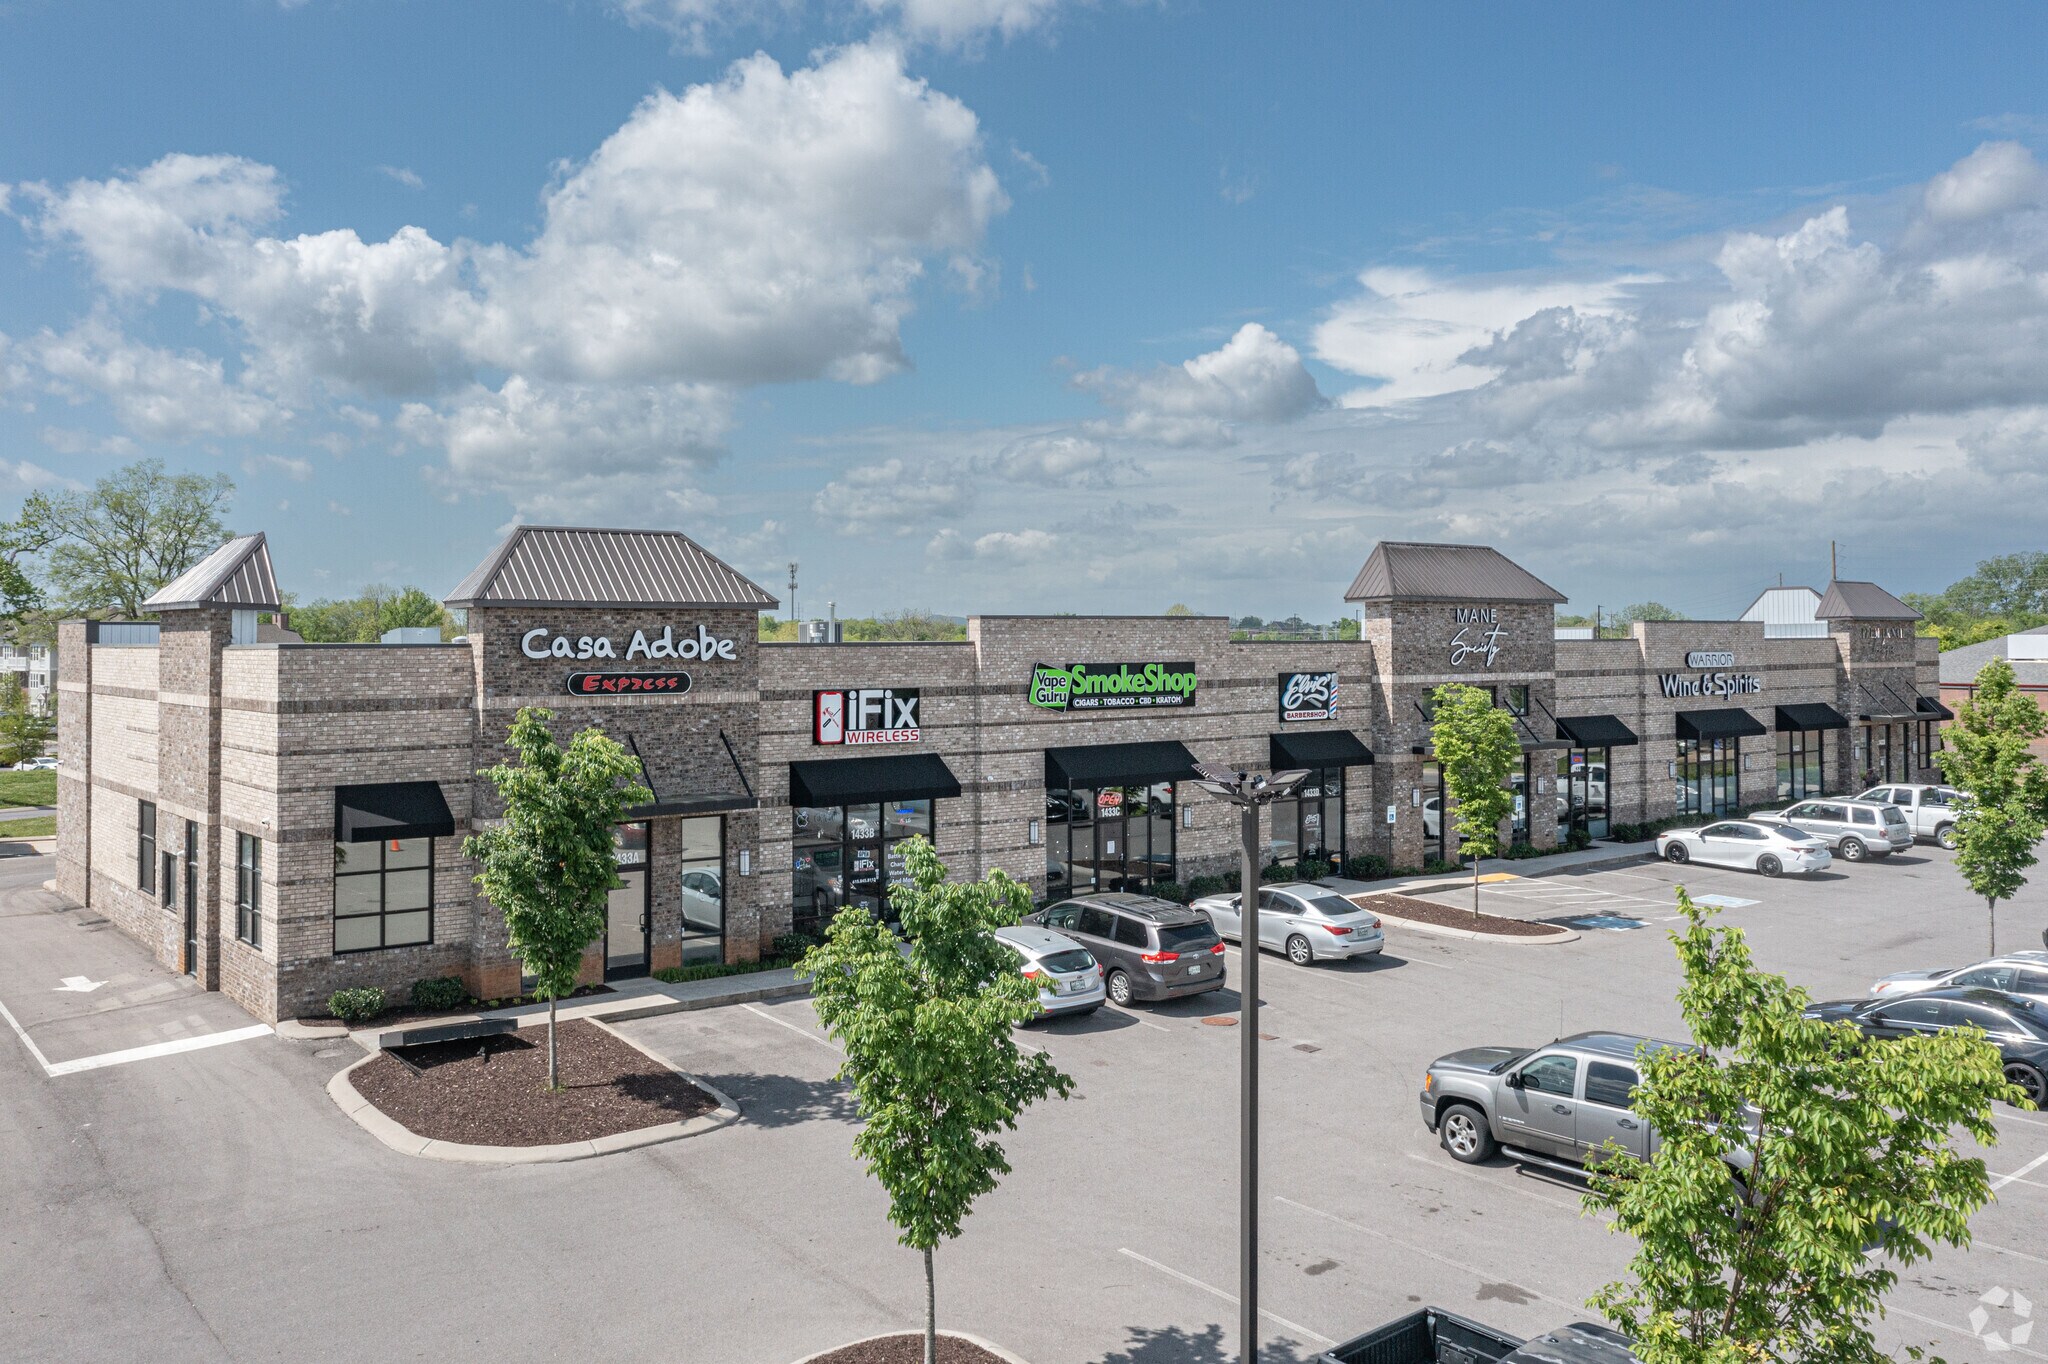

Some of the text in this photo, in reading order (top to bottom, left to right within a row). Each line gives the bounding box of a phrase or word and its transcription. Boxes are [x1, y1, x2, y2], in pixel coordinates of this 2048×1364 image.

[1457, 608, 1497, 624] MANE
[521, 625, 737, 661] Casa Adobe
[1450, 623, 1509, 668] Society
[1690, 653, 1734, 667] WARRIOR
[582, 674, 678, 693] Express
[1036, 671, 1067, 688] Vape
[1071, 663, 1198, 698] SmokeShop
[1660, 672, 1761, 701] Wine & Spirits
[1036, 687, 1068, 705] Guru
[1074, 696, 1182, 707] CIGARS TOBACCO CBD KRATOM
[848, 689, 919, 730] iFix
[1286, 711, 1327, 719] BARBERSHOP
[847, 730, 919, 743] WIRELESS
[1098, 794, 1121, 806] OPEN
[1101, 806, 1121, 818] 1433C
[850, 828, 875, 839] 1433B
[615, 852, 640, 865] 433A
